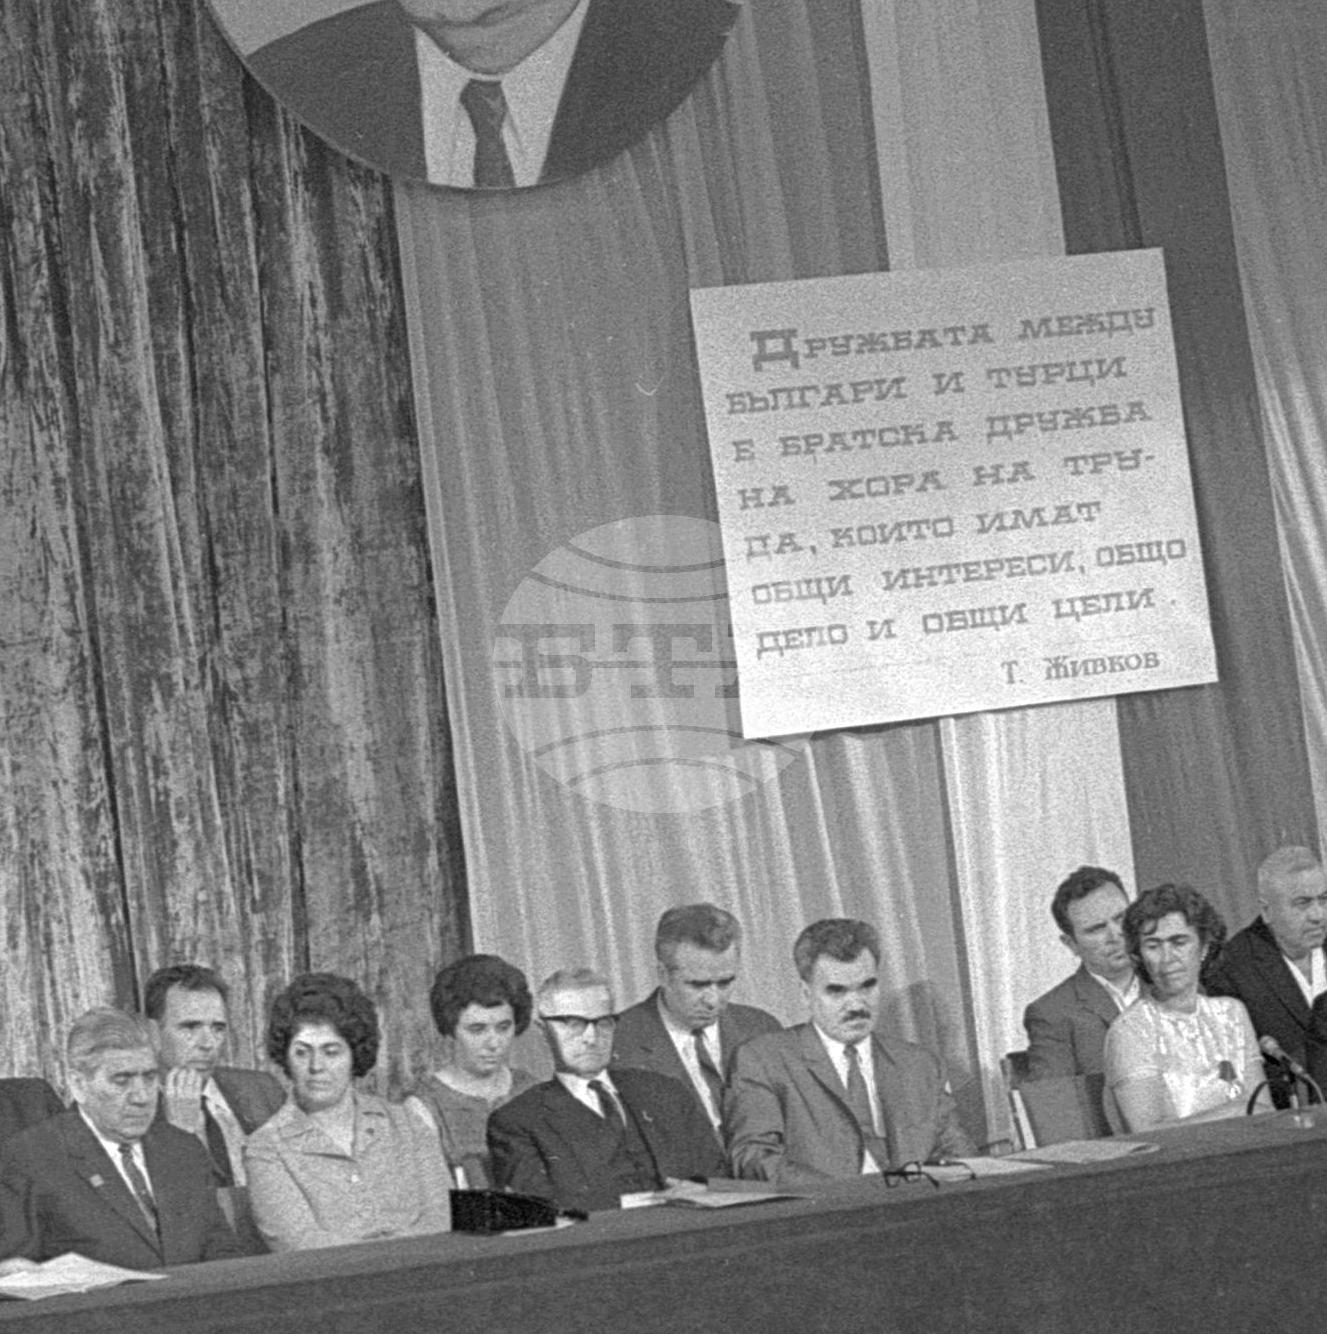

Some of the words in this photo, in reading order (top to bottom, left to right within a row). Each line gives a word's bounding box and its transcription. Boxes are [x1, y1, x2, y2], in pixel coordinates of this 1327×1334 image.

[749, 323, 995, 372] ДРУЖБАТА
[1018, 306, 1156, 340] МЕЖДУ
[725, 376, 908, 416] БЪЛГАРИ
[932, 370, 966, 396] И
[986, 356, 1128, 389] ТУРЦИ
[732, 438, 756, 463] Е
[779, 420, 960, 457] БРАТСКА
[985, 400, 1153, 444] ДРУЖБА
[737, 485, 796, 511] НА
[827, 470, 948, 502] ХОРА
[973, 461, 1036, 487] НА
[1063, 447, 1156, 477] ТРУ-
[744, 532, 817, 565] ДА,
[829, 517, 955, 549] КОИТО
[975, 500, 1102, 535] ИМАТ
[752, 573, 854, 606] ОБЩИ
[881, 550, 1086, 592] ИНТЕРЕСИ,
[1096, 538, 1187, 567] ОБЩО
[756, 623, 848, 661] ДЕЛО
[866, 618, 897, 641] И
[922, 602, 1029, 636] ОБЩИ
